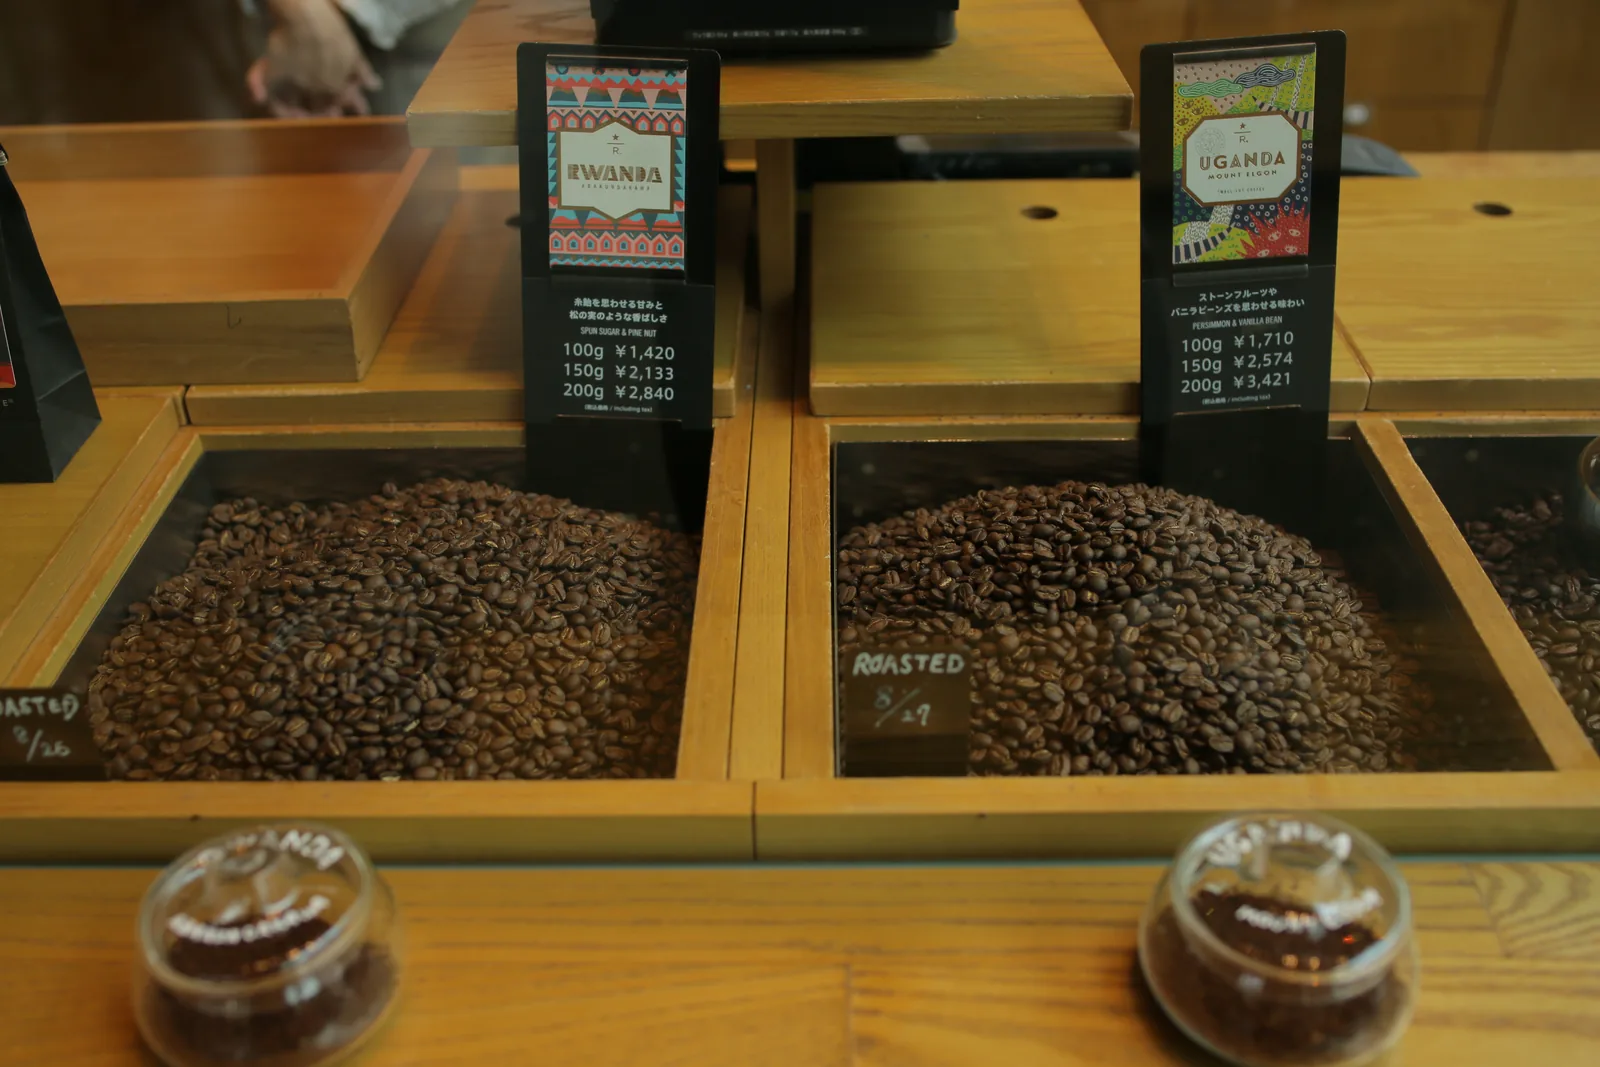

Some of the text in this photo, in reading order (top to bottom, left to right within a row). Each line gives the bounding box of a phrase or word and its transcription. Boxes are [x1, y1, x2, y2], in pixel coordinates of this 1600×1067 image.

[1199, 151, 1285, 170] UGANDA
[567, 163, 662, 183] RWANDA
[1207, 169, 1277, 180] MOUNT ELGON
[1199, 287, 1278, 302] ストーンフルーツや
[1170, 298, 1305, 317] バニラビーンズを思わせる味わい
[569, 310, 668, 323] 松の実のような香ばしさ
[1192, 315, 1283, 330] PERSIMMON & VANILLA BEAN
[580, 326, 657, 338] SPUN SUGAR & PINE NUT
[563, 342, 604, 360] 100g
[1181, 337, 1222, 354] 100g
[563, 363, 604, 380] 150g
[1181, 357, 1222, 374] 150g
[563, 383, 604, 401] 200g
[1181, 378, 1222, 394] 200g
[852, 652, 965, 676] ROASTED
[0, 694, 79, 721] ASTED
